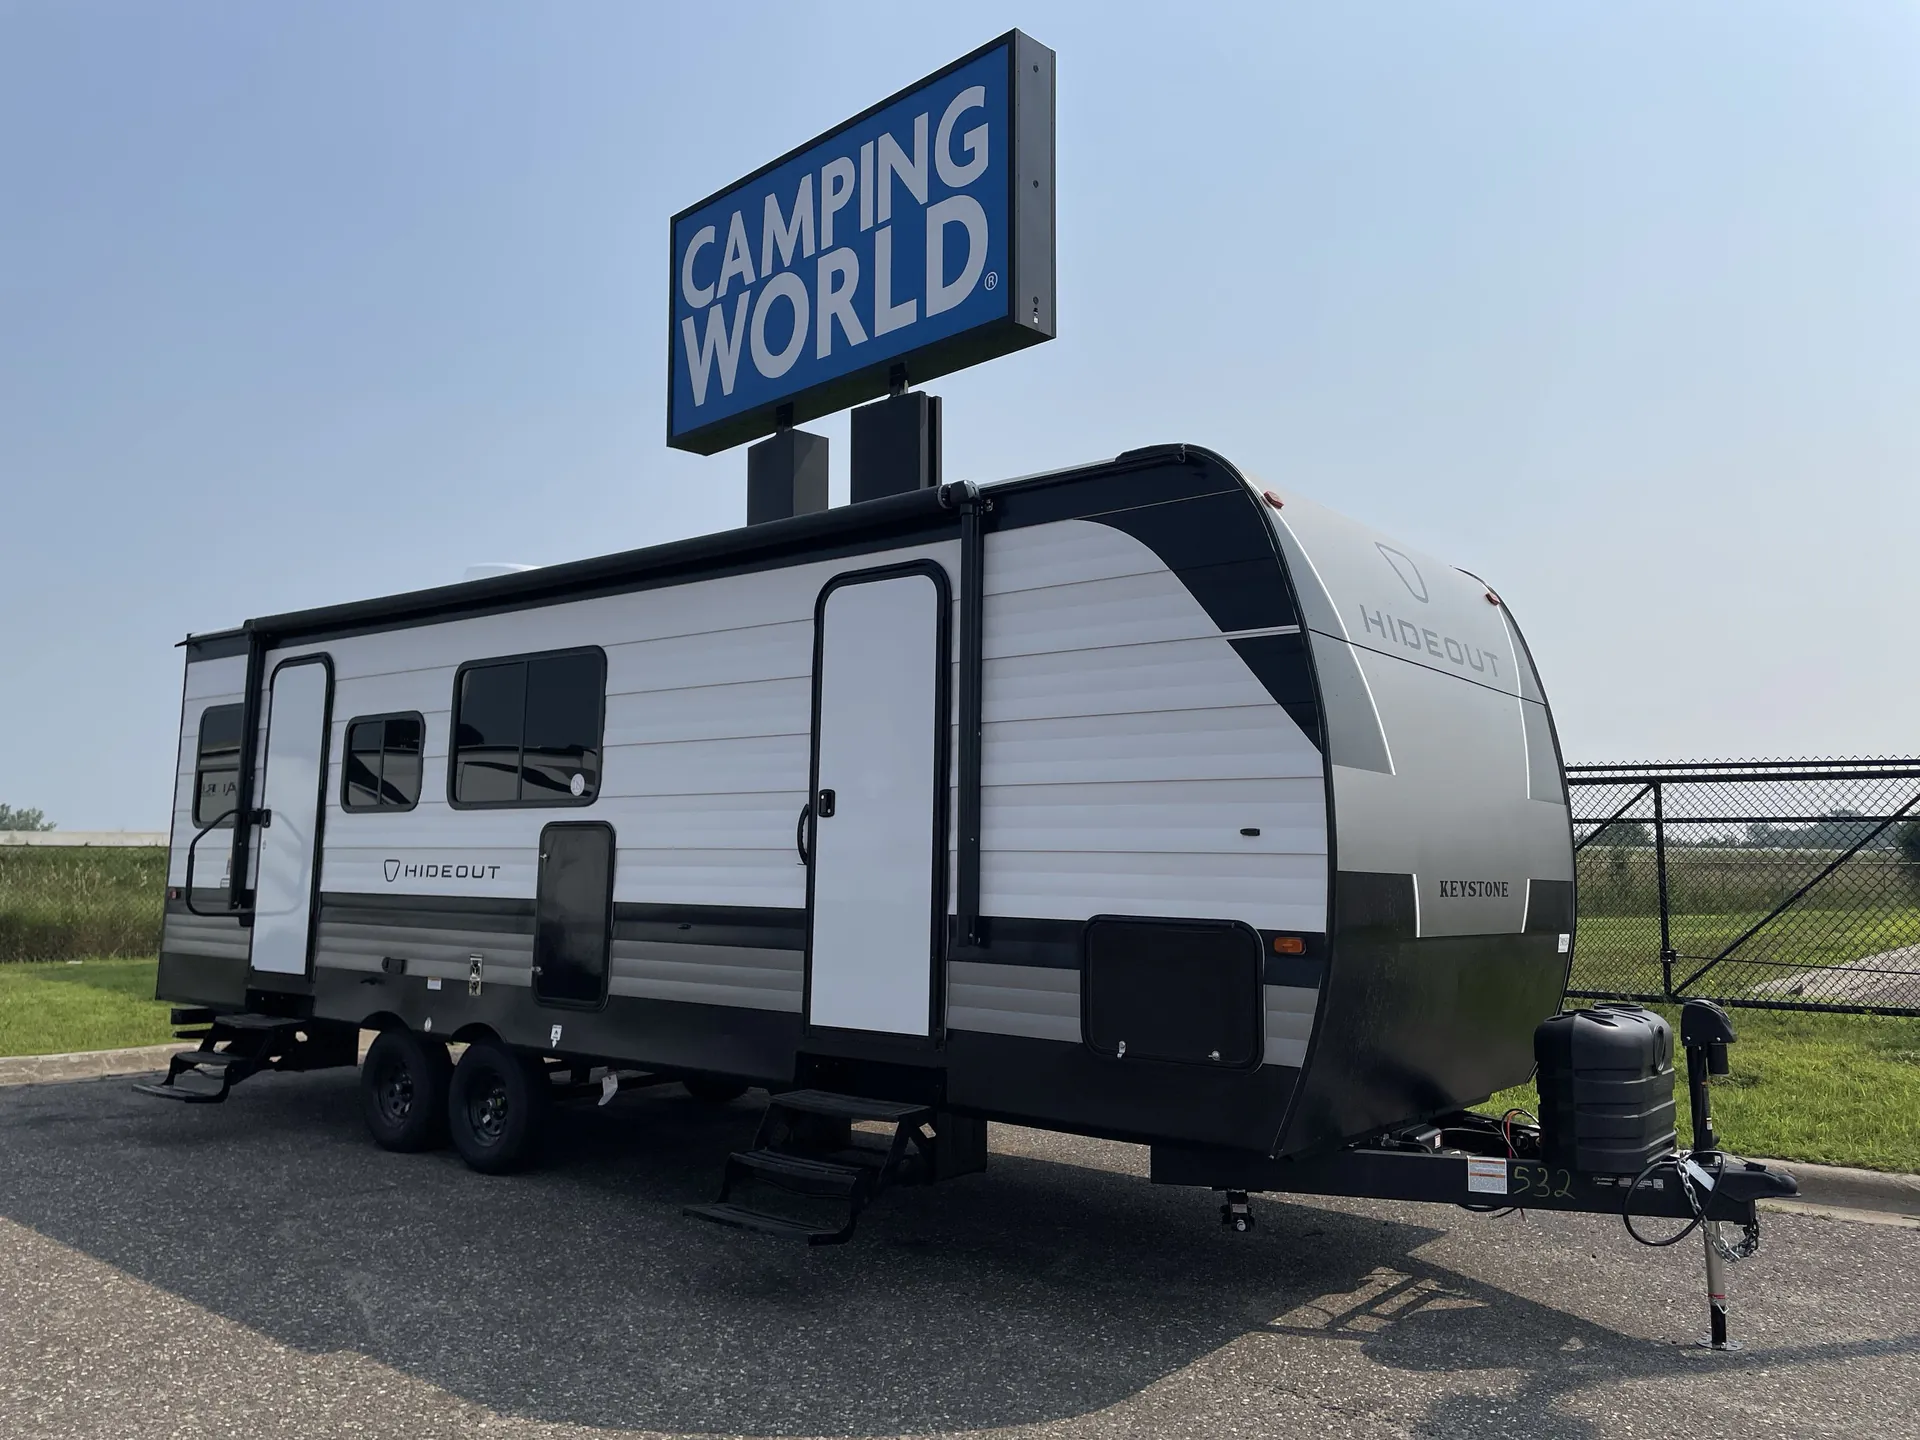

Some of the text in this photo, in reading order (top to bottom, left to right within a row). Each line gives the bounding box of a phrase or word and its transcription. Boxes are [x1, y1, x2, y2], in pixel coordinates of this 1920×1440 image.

[681, 85, 989, 309] CAMPING
[1359, 603, 1499, 677] HIDEOUT
[404, 864, 501, 879] HIDEOUT
[1439, 880, 1509, 898] KEYSTONE
[1513, 1166, 1576, 1200] 532
